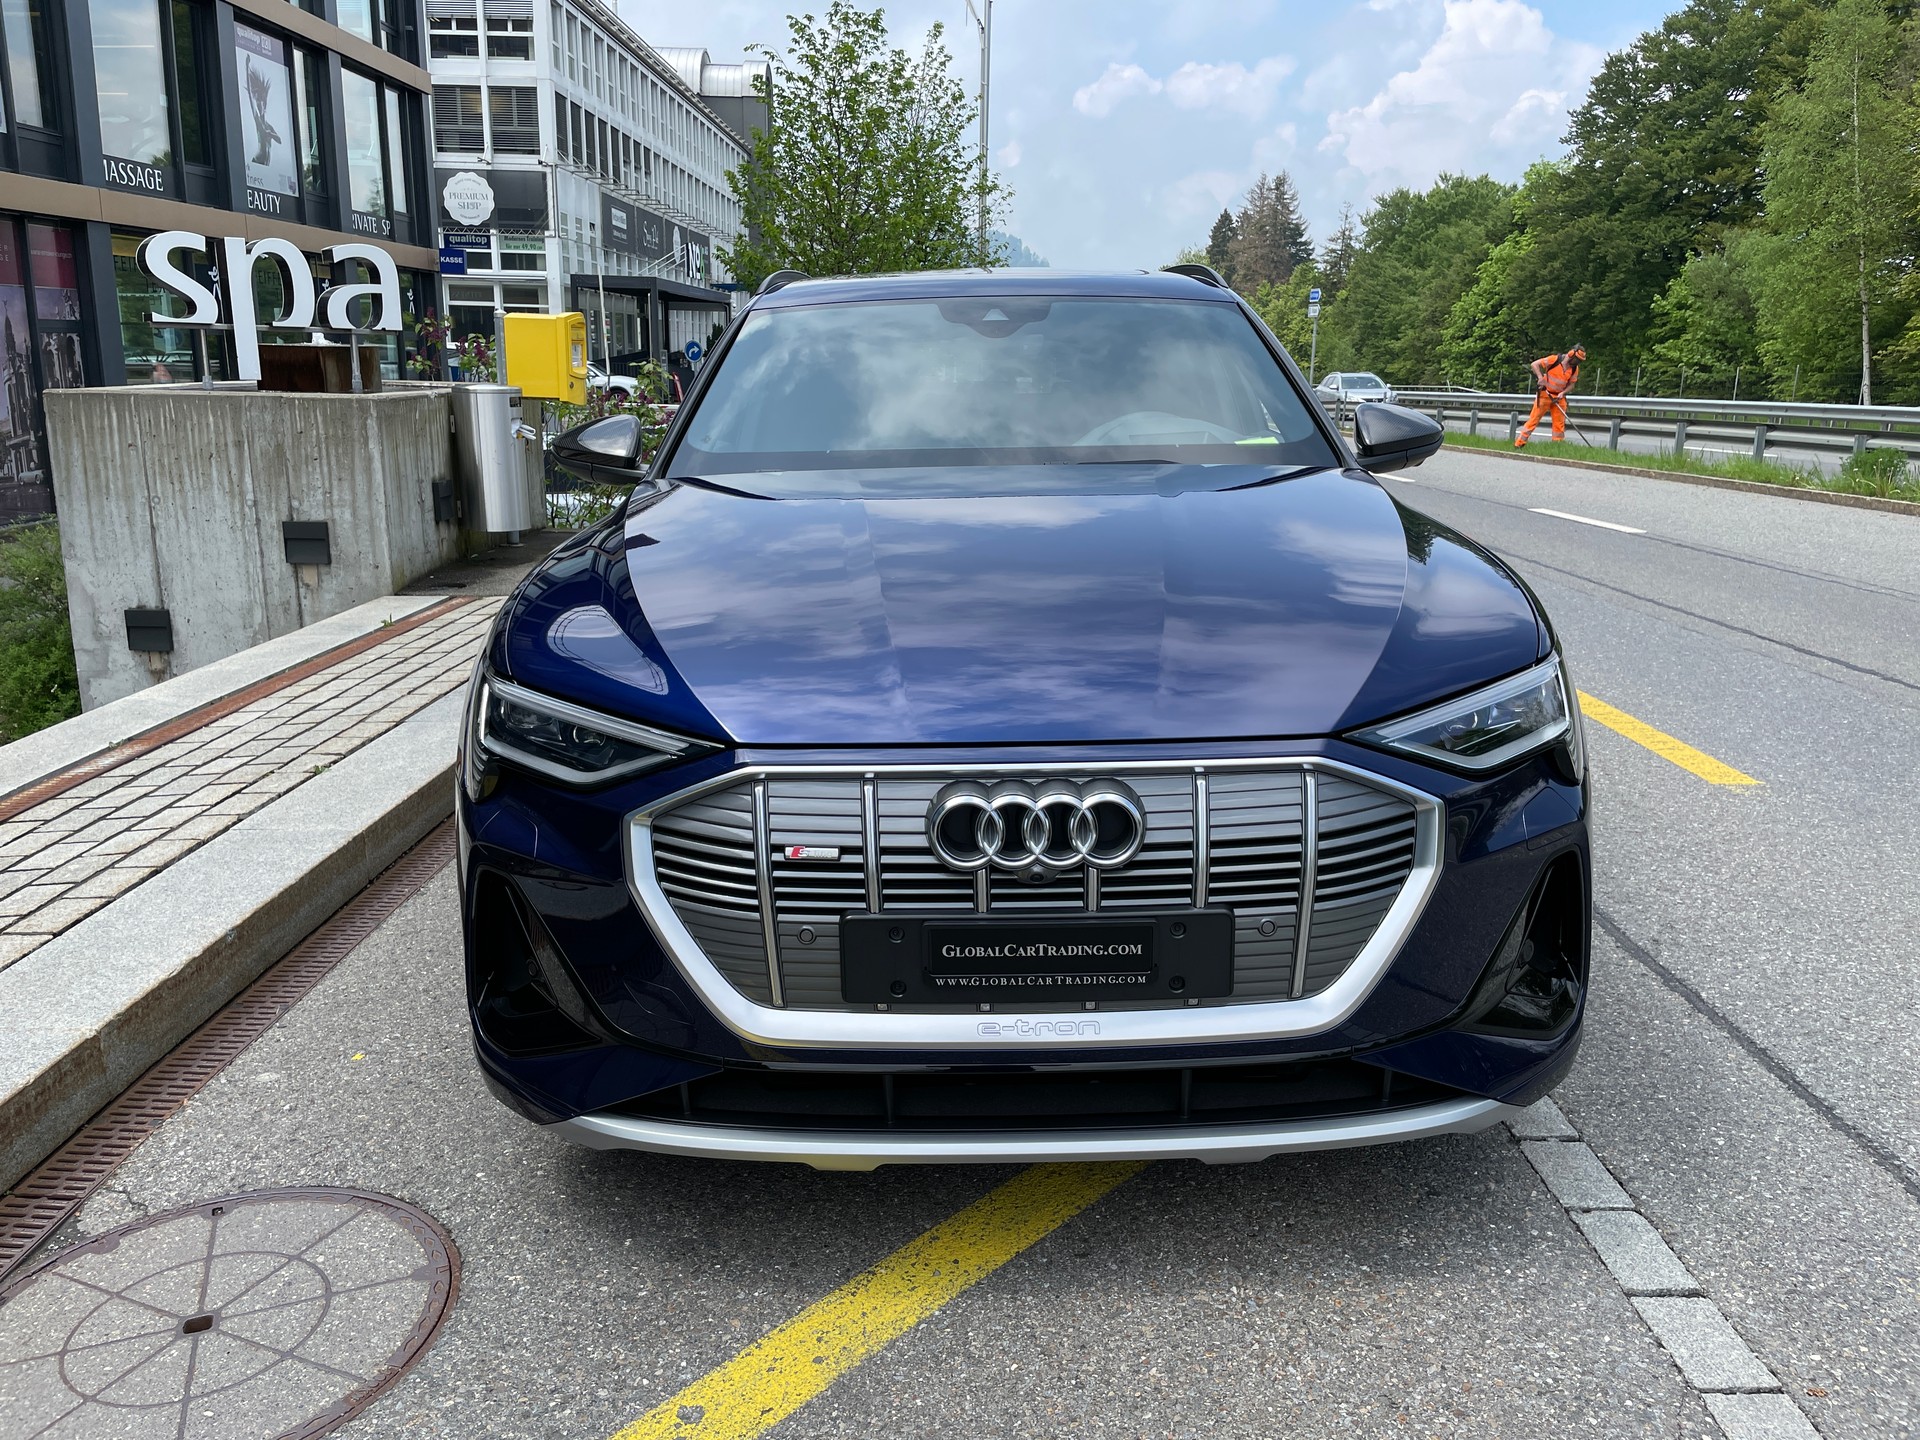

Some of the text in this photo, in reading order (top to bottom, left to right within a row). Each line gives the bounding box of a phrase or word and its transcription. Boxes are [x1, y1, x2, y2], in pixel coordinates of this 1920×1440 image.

[247, 189, 281, 213] EAUTY
[448, 191, 489, 201] PREMIUM
[449, 234, 488, 244] qualitop
[440, 256, 464, 264] KASSE
[139, 230, 402, 381] spa
[977, 1018, 1101, 1036] e-tron
